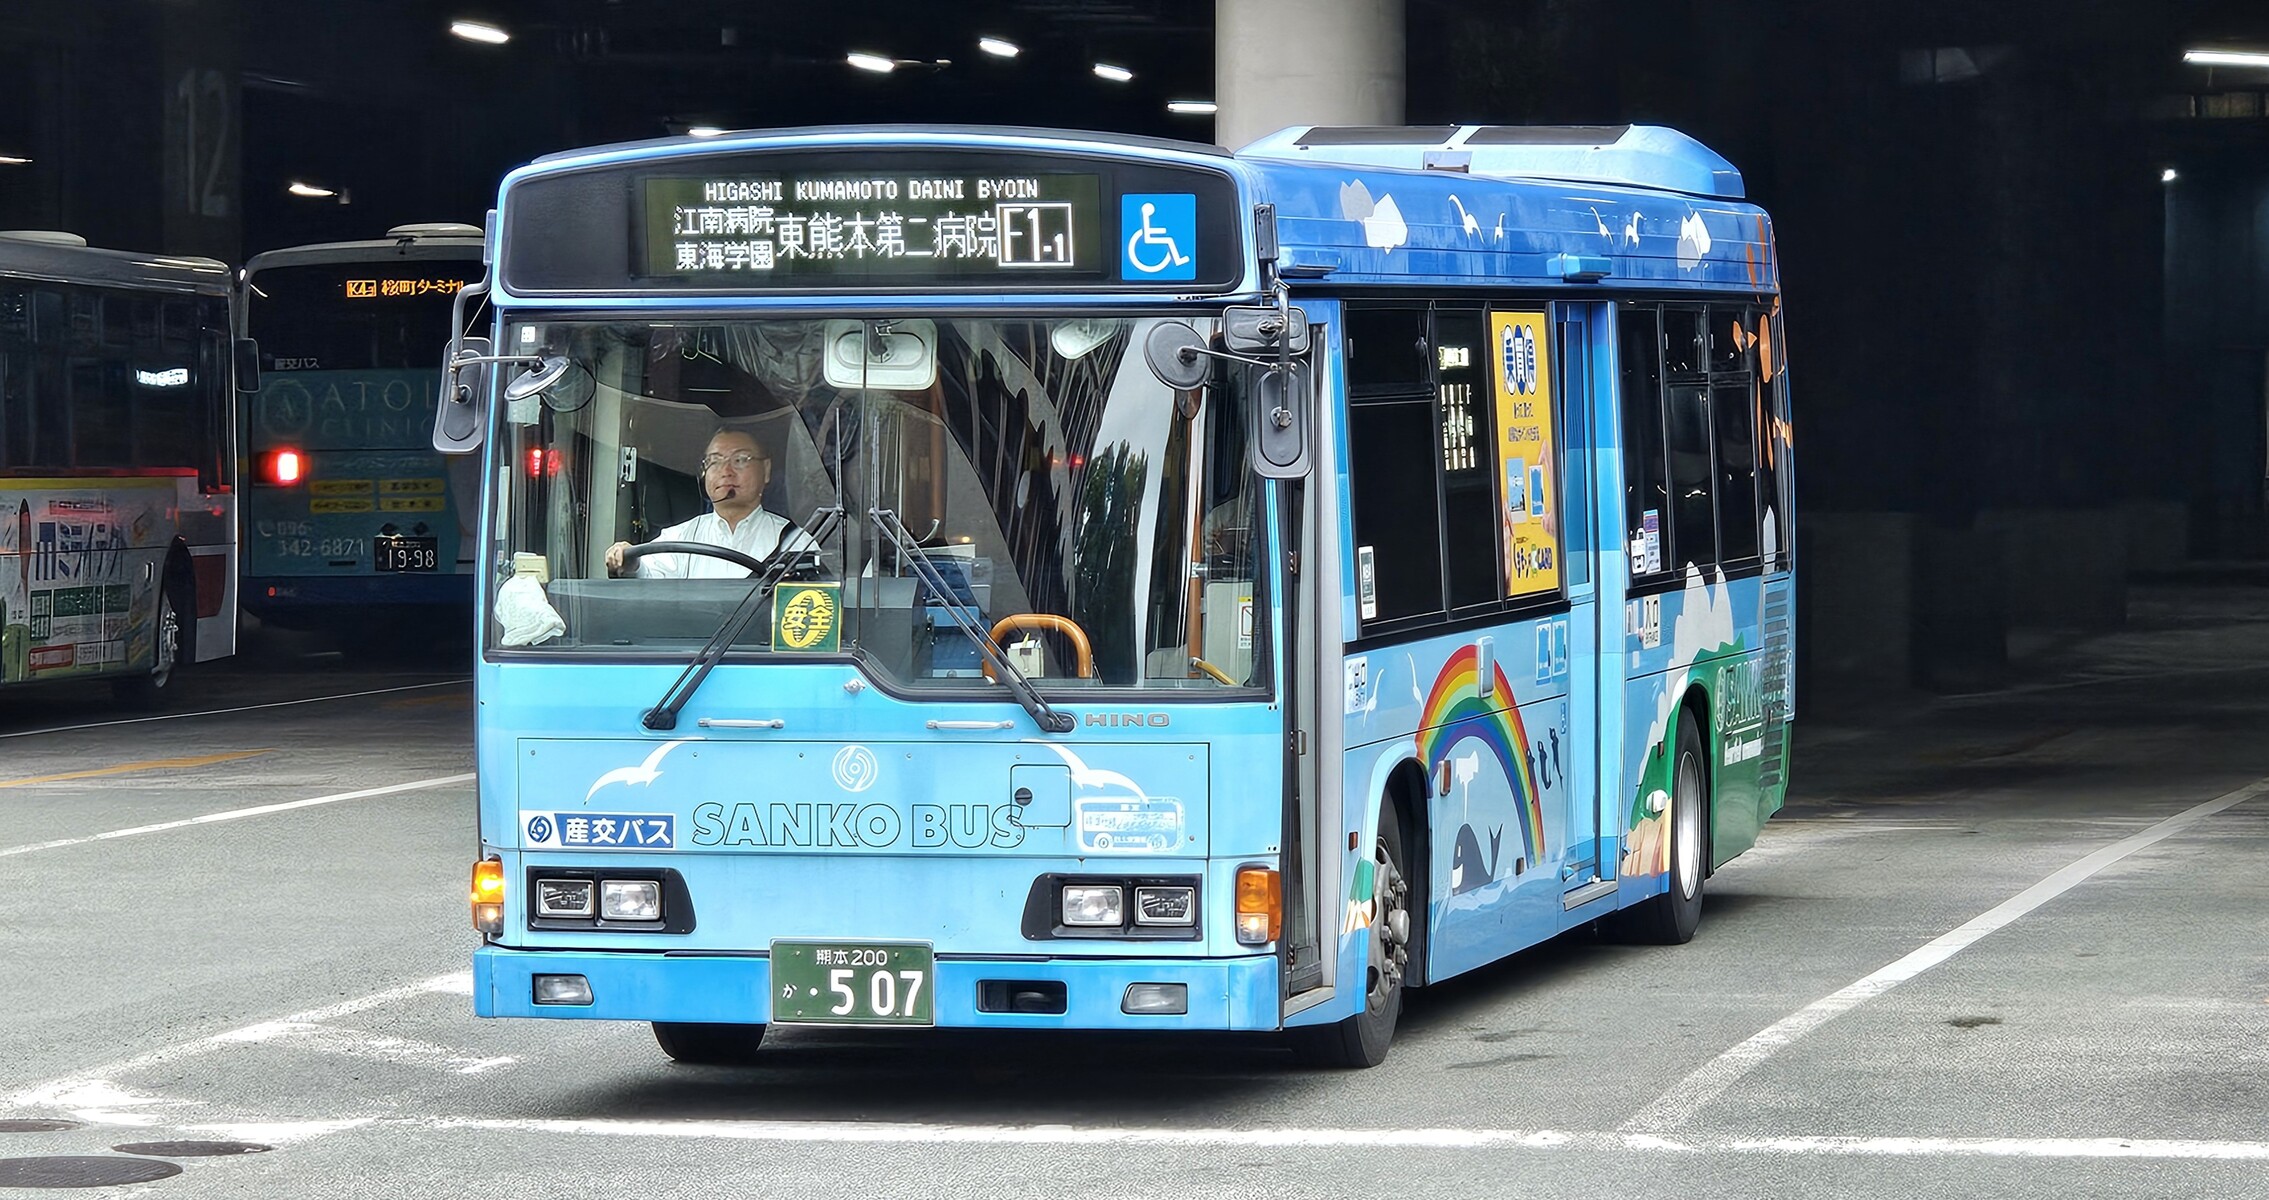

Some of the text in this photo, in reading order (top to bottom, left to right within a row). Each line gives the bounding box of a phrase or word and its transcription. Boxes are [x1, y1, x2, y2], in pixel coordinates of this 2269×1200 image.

[705, 179, 1038, 201] HIGASHI KUMAMOTO DAINI BYOIN
[674, 205, 774, 235] 江南病院
[774, 210, 997, 259] 東熊本第二病院
[675, 240, 774, 269] 東海学園
[783, 605, 832, 630] 安全
[1085, 713, 1170, 728] HINO
[564, 817, 672, 844] 産交バス
[692, 802, 901, 848] SANKO
[912, 804, 1026, 849] BUS
[782, 983, 798, 999] か
